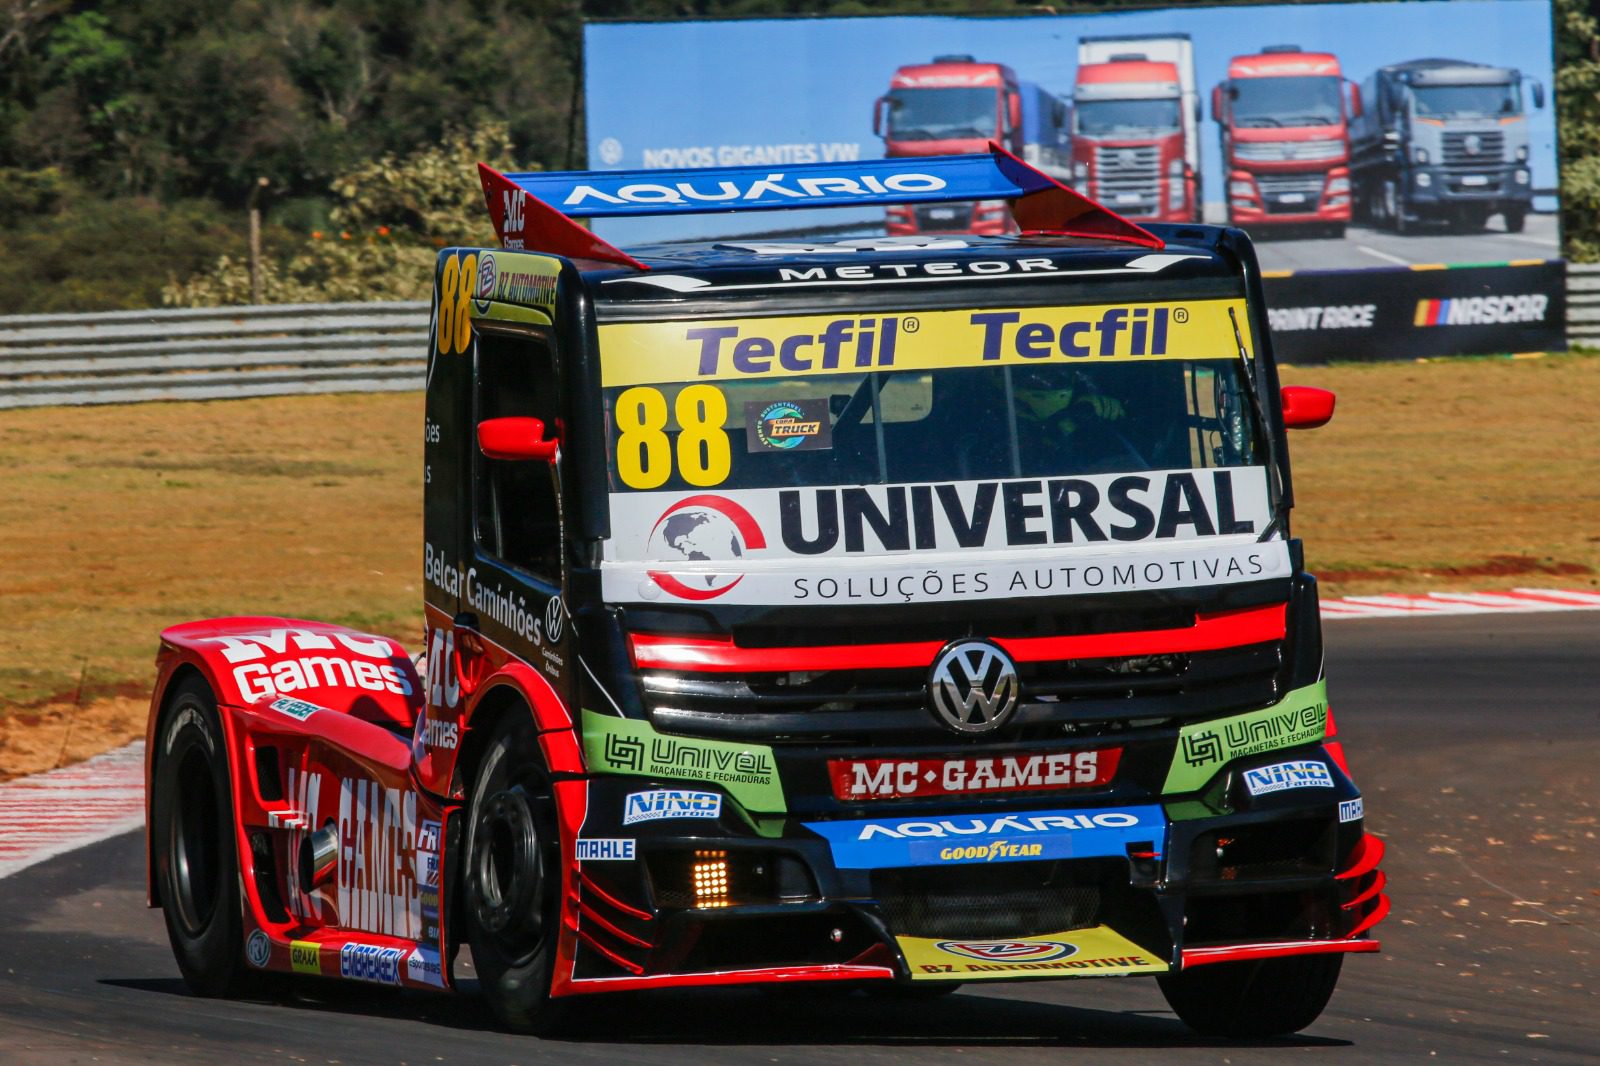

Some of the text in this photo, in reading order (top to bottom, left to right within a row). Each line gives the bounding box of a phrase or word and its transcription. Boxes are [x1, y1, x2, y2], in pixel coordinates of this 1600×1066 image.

[644, 143, 860, 168] NOVOS GIGANTES VW
[564, 173, 946, 205] AQUÁRIO
[504, 189, 525, 232] MC
[780, 259, 1058, 281] METEOR
[509, 272, 557, 304] AUTOMOTIVE
[438, 254, 477, 355] 88
[1267, 304, 1377, 331] PRINT RACE
[1448, 294, 1548, 325] NASCAR
[615, 384, 731, 489] 88
[774, 424, 816, 434] TRUCK
[779, 471, 1254, 555] UNIVERSAL
[425, 542, 541, 646] Belcar Caminhões
[794, 555, 1262, 602] SOLUÇÕES AUTOMOTIVAS
[233, 656, 413, 704] Games
[425, 718, 458, 749] ames
[650, 765, 771, 785] MAÇANETAS E FECHADURAS
[942, 751, 1098, 791] GAMES
[858, 813, 1139, 840] AQUÁRIO
[337, 777, 422, 941] GAMES
[576, 841, 634, 859] MAHLE
[940, 841, 1042, 861] GOODYEAR
[292, 948, 319, 967] GRAXA
[920, 956, 1151, 973] BZ AUTOMOTIVE
